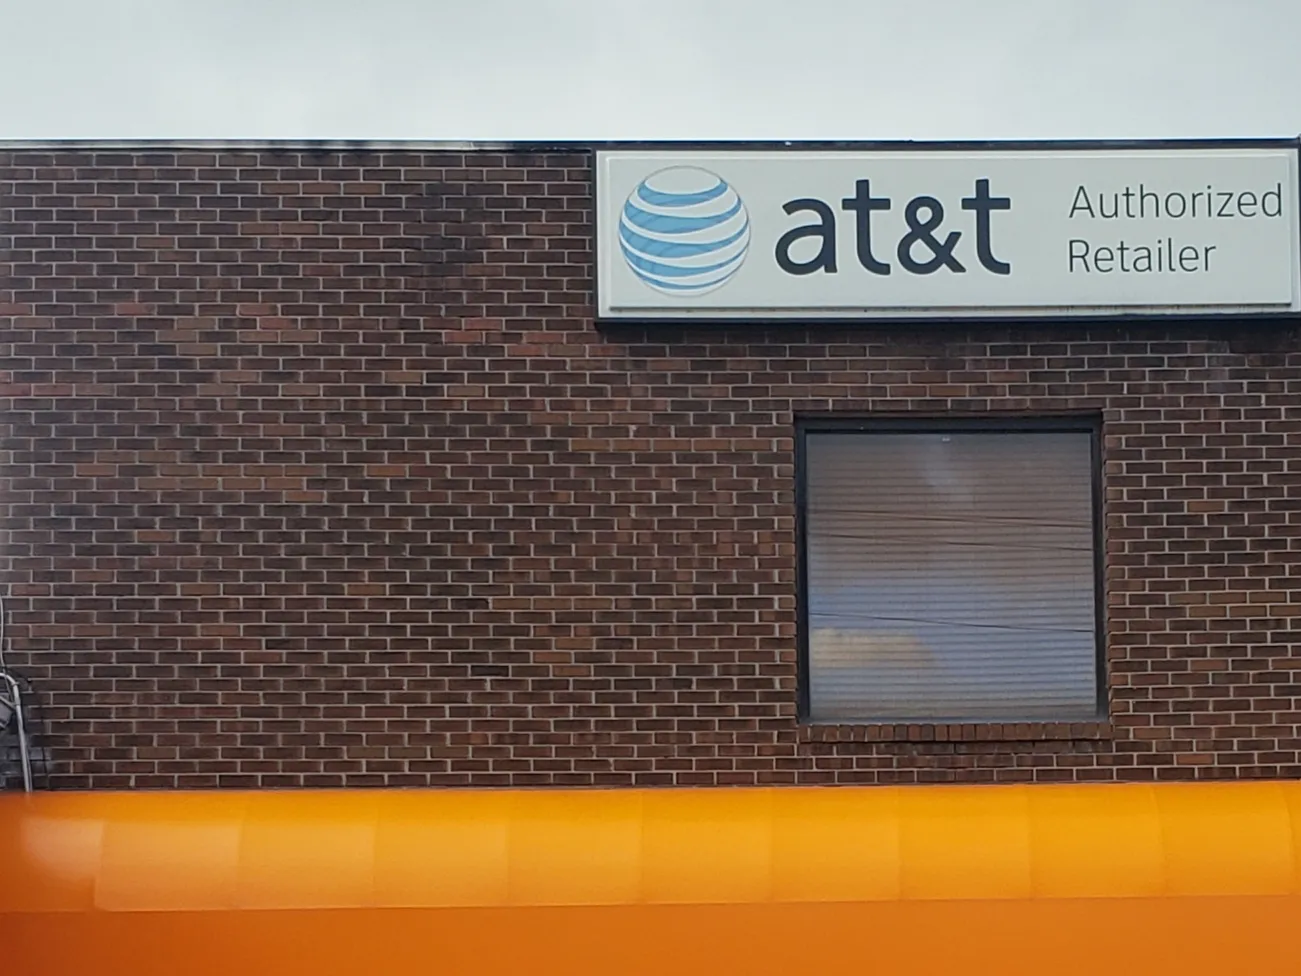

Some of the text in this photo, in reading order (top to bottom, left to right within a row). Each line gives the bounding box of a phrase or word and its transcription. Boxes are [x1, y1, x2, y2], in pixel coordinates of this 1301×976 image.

[1068, 182, 1284, 220] Authorized
[774, 178, 1012, 275] at&t
[1067, 237, 1217, 273] Retailer
